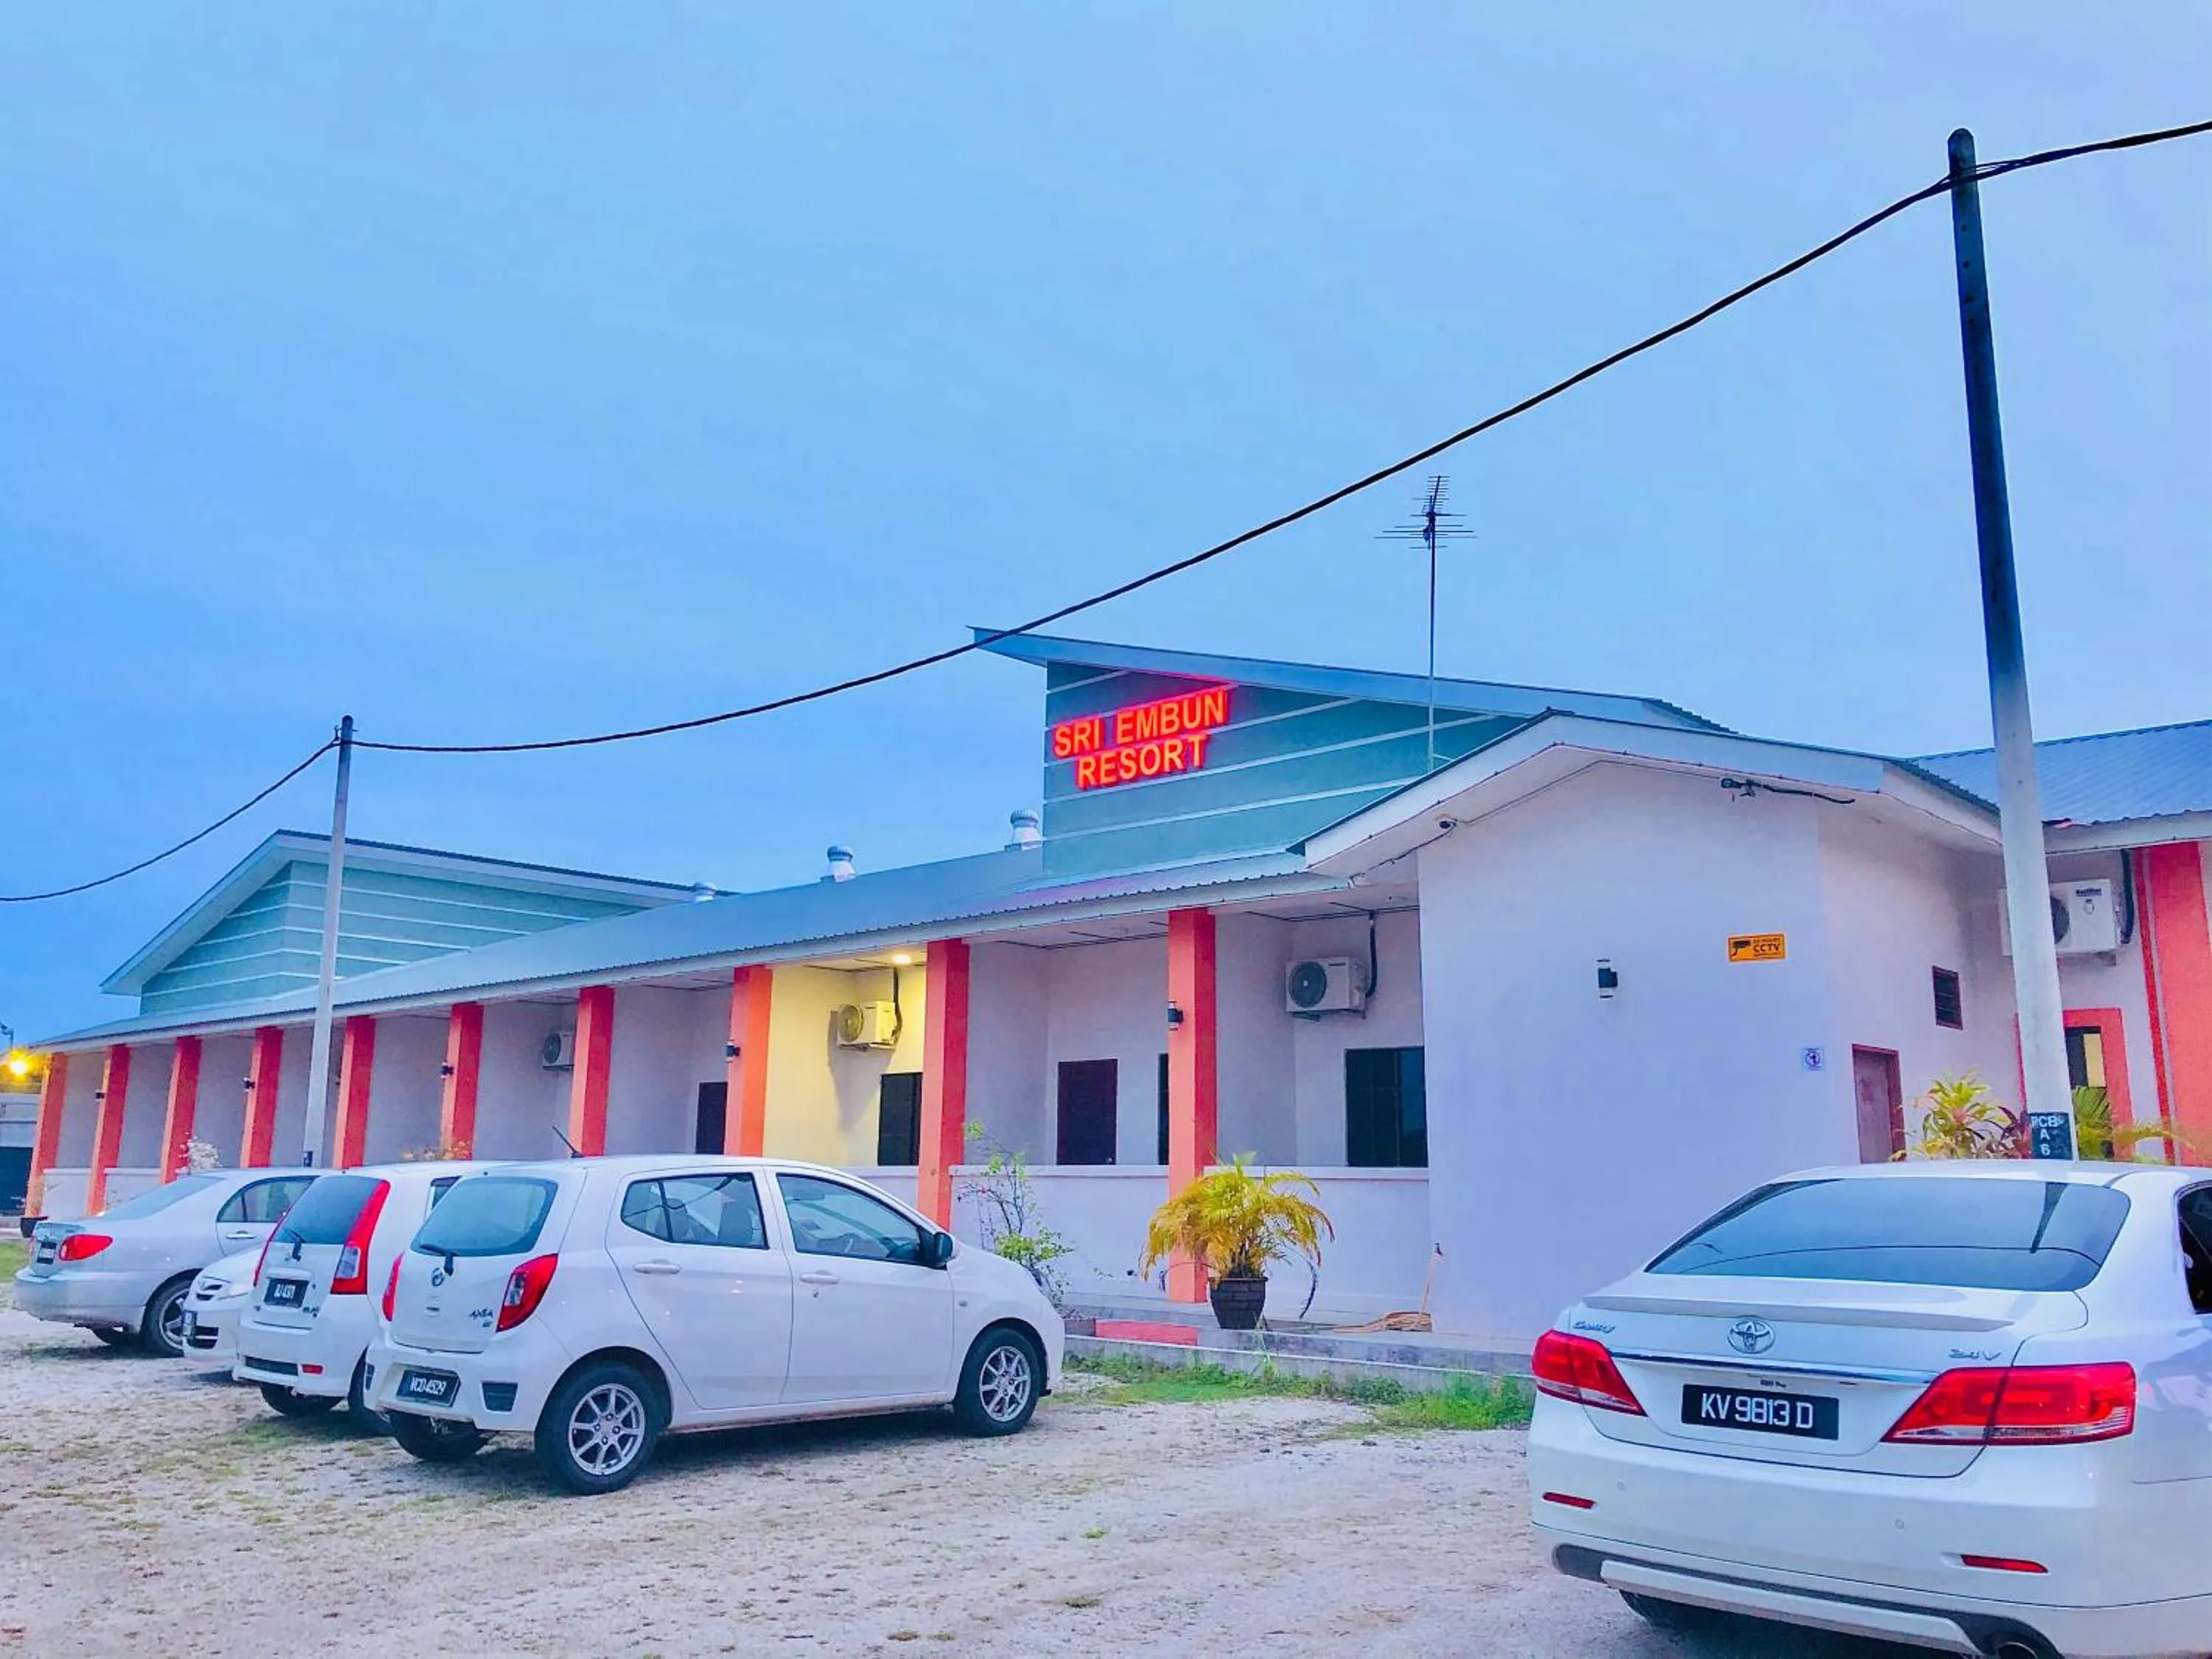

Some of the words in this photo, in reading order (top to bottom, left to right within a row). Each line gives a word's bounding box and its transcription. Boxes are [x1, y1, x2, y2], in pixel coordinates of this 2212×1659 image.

[1054, 719, 1100, 757] SRI
[1116, 689, 1228, 744] EMBUN
[1077, 734, 1207, 788] RESORT
[1753, 943, 1781, 953] CCTV
[2040, 1128, 2050, 1141] A
[1701, 1393, 1731, 1420] KV
[1735, 1396, 1790, 1427] 9813
[1795, 1402, 1814, 1430] D
